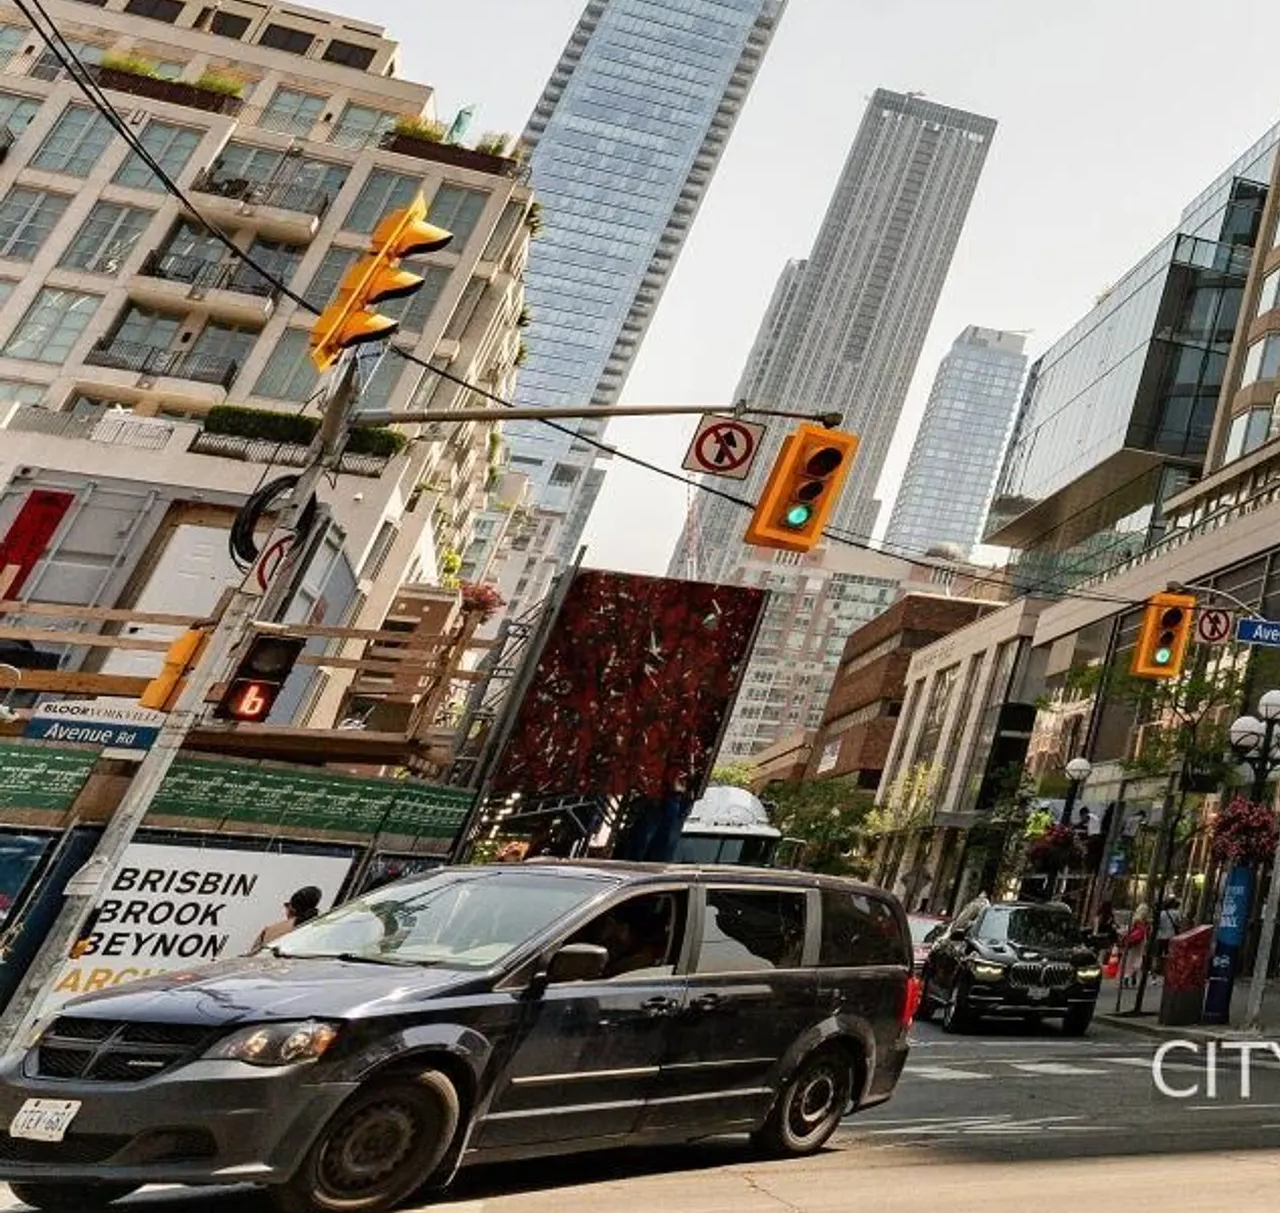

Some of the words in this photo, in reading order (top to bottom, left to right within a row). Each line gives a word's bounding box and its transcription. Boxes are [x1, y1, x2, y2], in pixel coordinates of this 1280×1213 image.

[44, 722, 114, 743] Avenue
[115, 732, 136, 745] Rd
[112, 867, 258, 897] BRISBIN
[99, 899, 226, 926] BROOK
[77, 932, 229, 959] BEYNON
